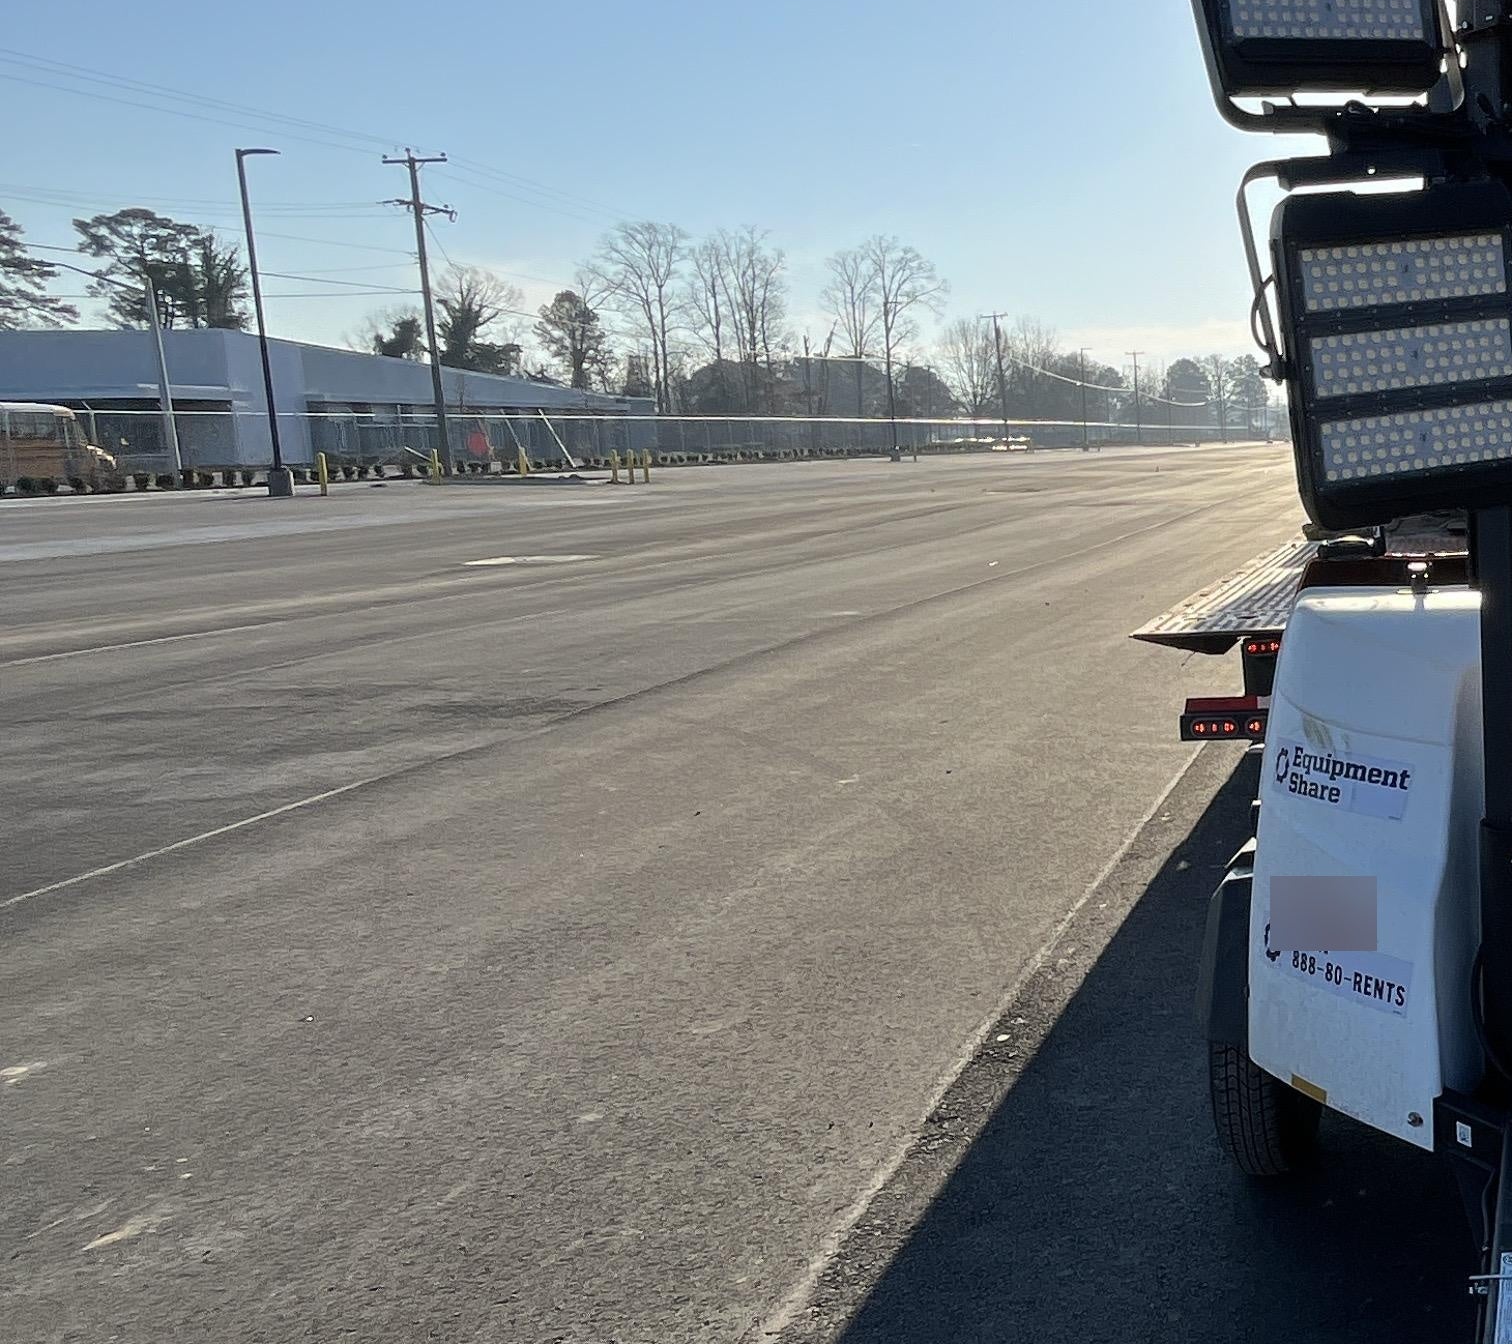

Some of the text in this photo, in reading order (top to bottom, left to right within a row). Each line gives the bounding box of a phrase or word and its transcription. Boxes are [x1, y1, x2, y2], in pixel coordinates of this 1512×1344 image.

[1288, 771, 1341, 804] Share
[1292, 746, 1411, 791] Equipment
[1292, 950, 1406, 1007] 888-80-RENTS
